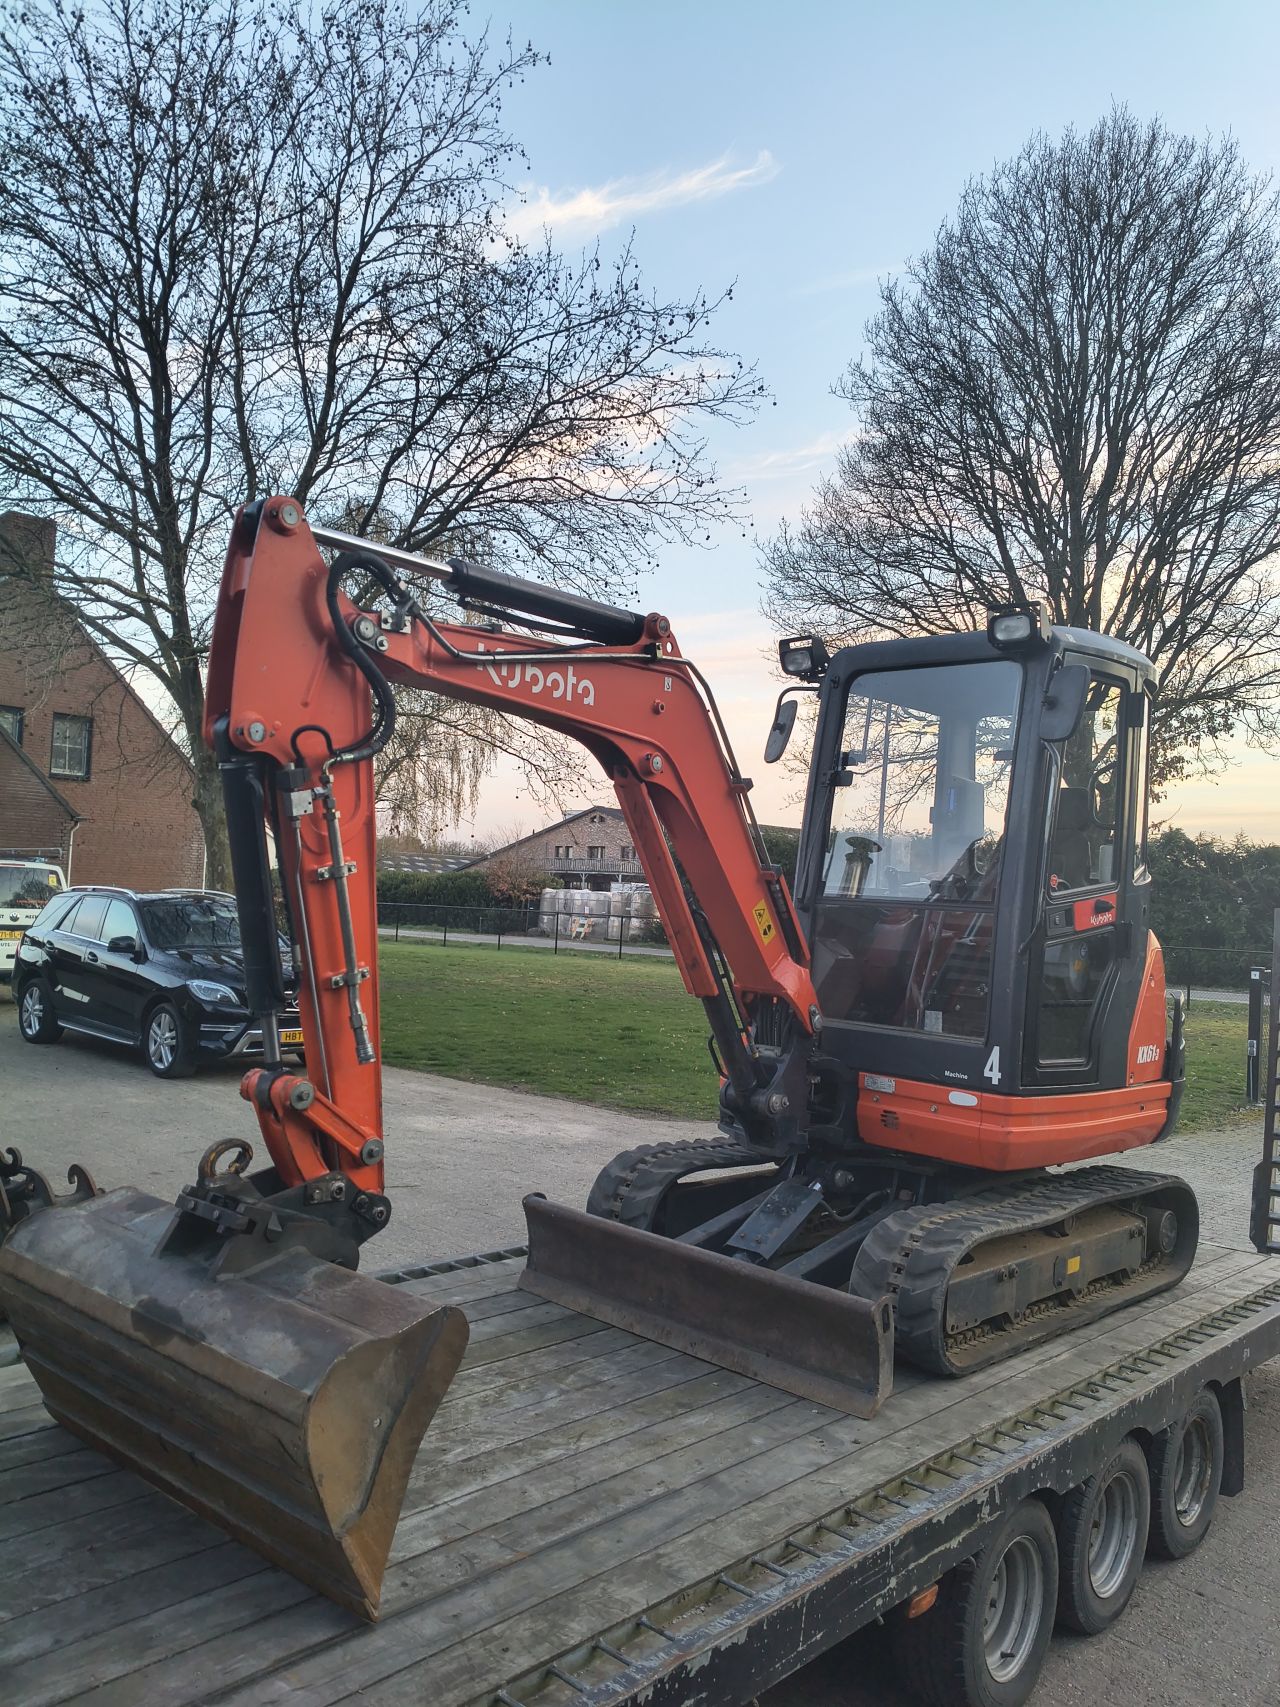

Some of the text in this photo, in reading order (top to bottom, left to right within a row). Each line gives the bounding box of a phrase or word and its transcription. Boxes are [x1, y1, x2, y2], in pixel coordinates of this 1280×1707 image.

[477, 642, 595, 706] Kubota
[1090, 911, 1112, 926] Kubota
[944, 1045, 1002, 1085] Machine 4
